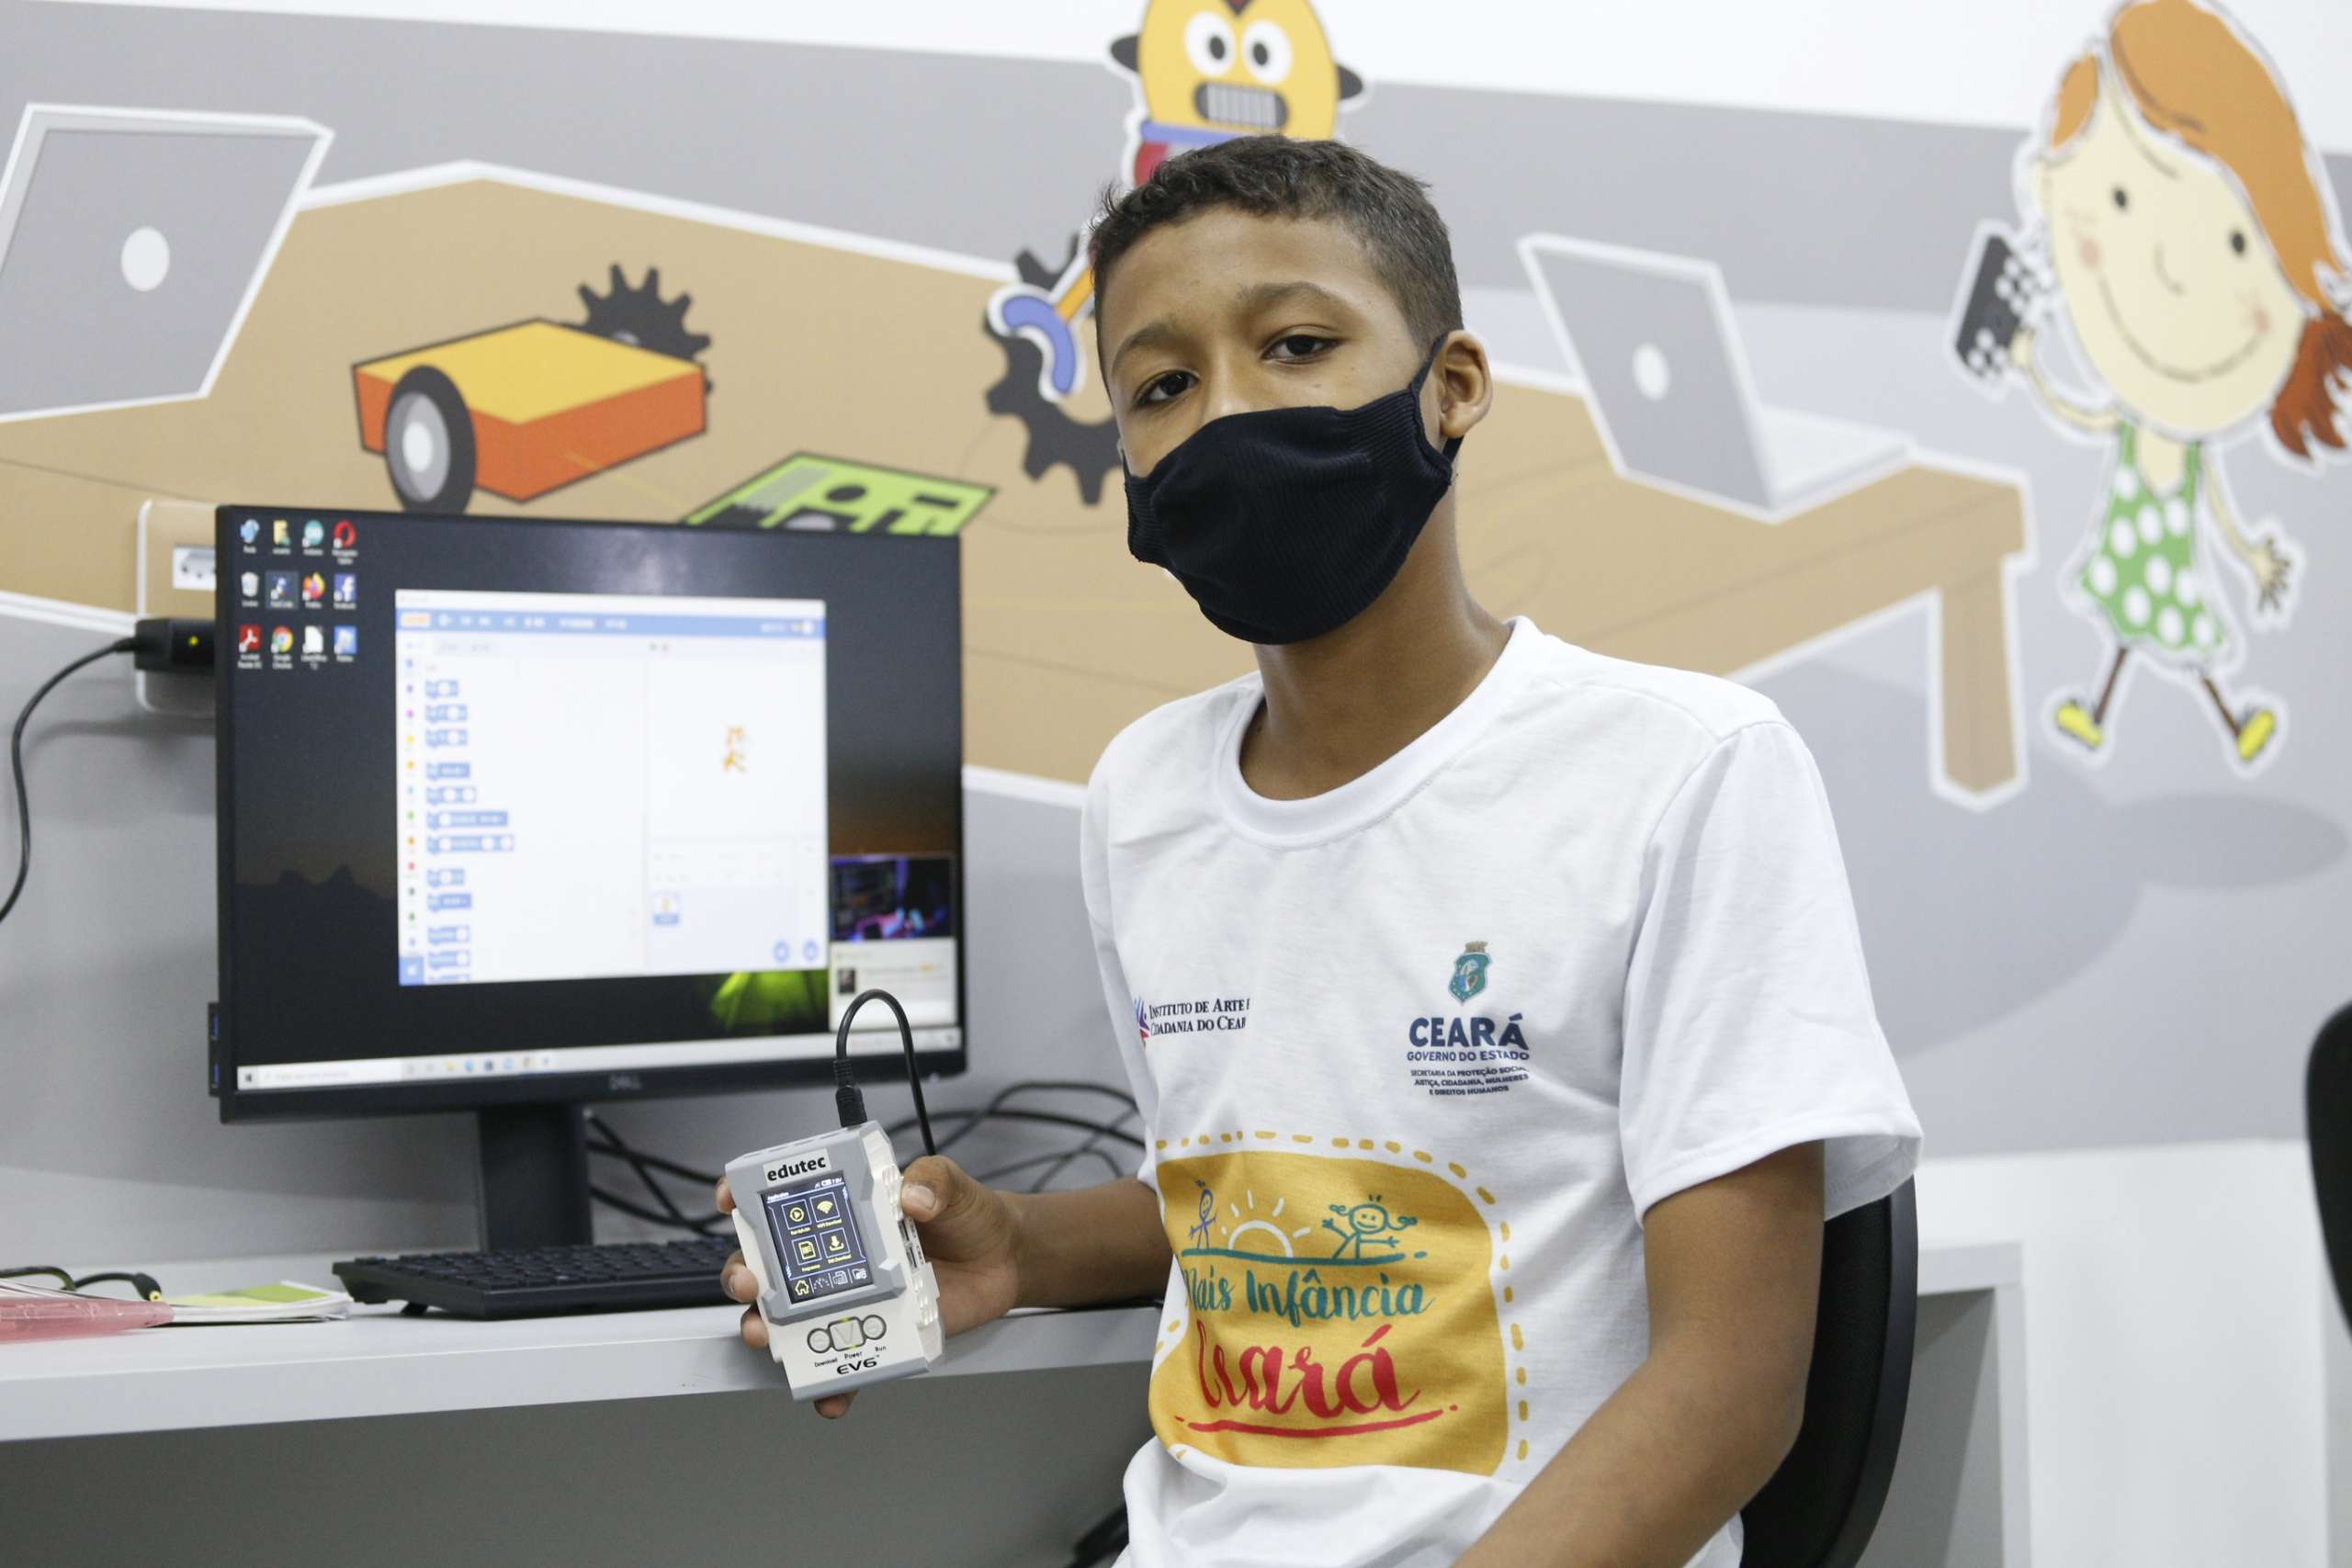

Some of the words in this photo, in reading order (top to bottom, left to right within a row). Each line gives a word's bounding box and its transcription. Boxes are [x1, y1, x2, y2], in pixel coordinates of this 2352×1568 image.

[1195, 1001, 1209, 1013] DE
[1213, 998, 1244, 1012] ARTE
[1196, 1020, 1214, 1031] DO
[1408, 1012, 1529, 1050] CEARÁ
[1407, 1051, 1456, 1061] GOVERNO
[1459, 1051, 1476, 1061] DO
[1480, 1050, 1530, 1061] ESTADO
[1457, 1066, 1498, 1077] PROTEÇÃO
[766, 1156, 827, 1182] edutec
[1246, 1269, 1434, 1327] Infância
[844, 1351, 863, 1359] Power
[836, 1357, 877, 1375] EV6
